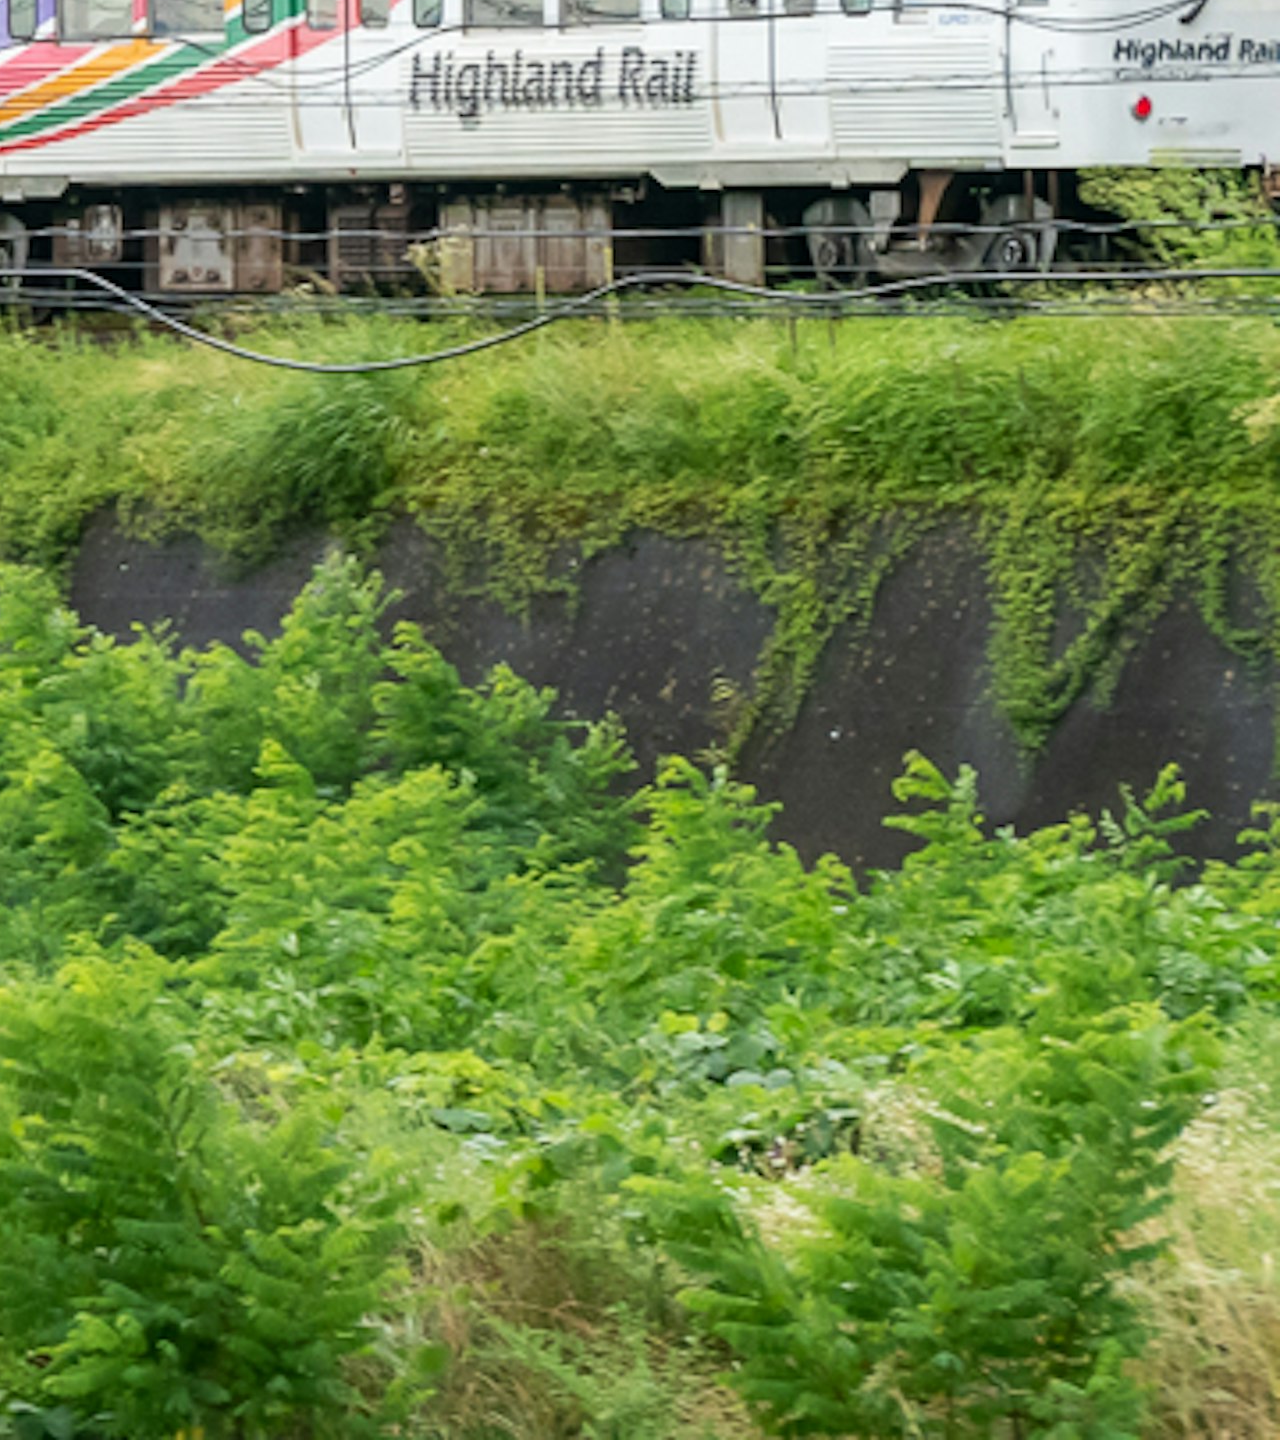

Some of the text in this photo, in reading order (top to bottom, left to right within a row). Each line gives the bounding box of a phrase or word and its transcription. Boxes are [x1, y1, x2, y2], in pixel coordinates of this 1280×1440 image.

[1113, 34, 1232, 70] Highland
[408, 46, 696, 131] Highland Rail
